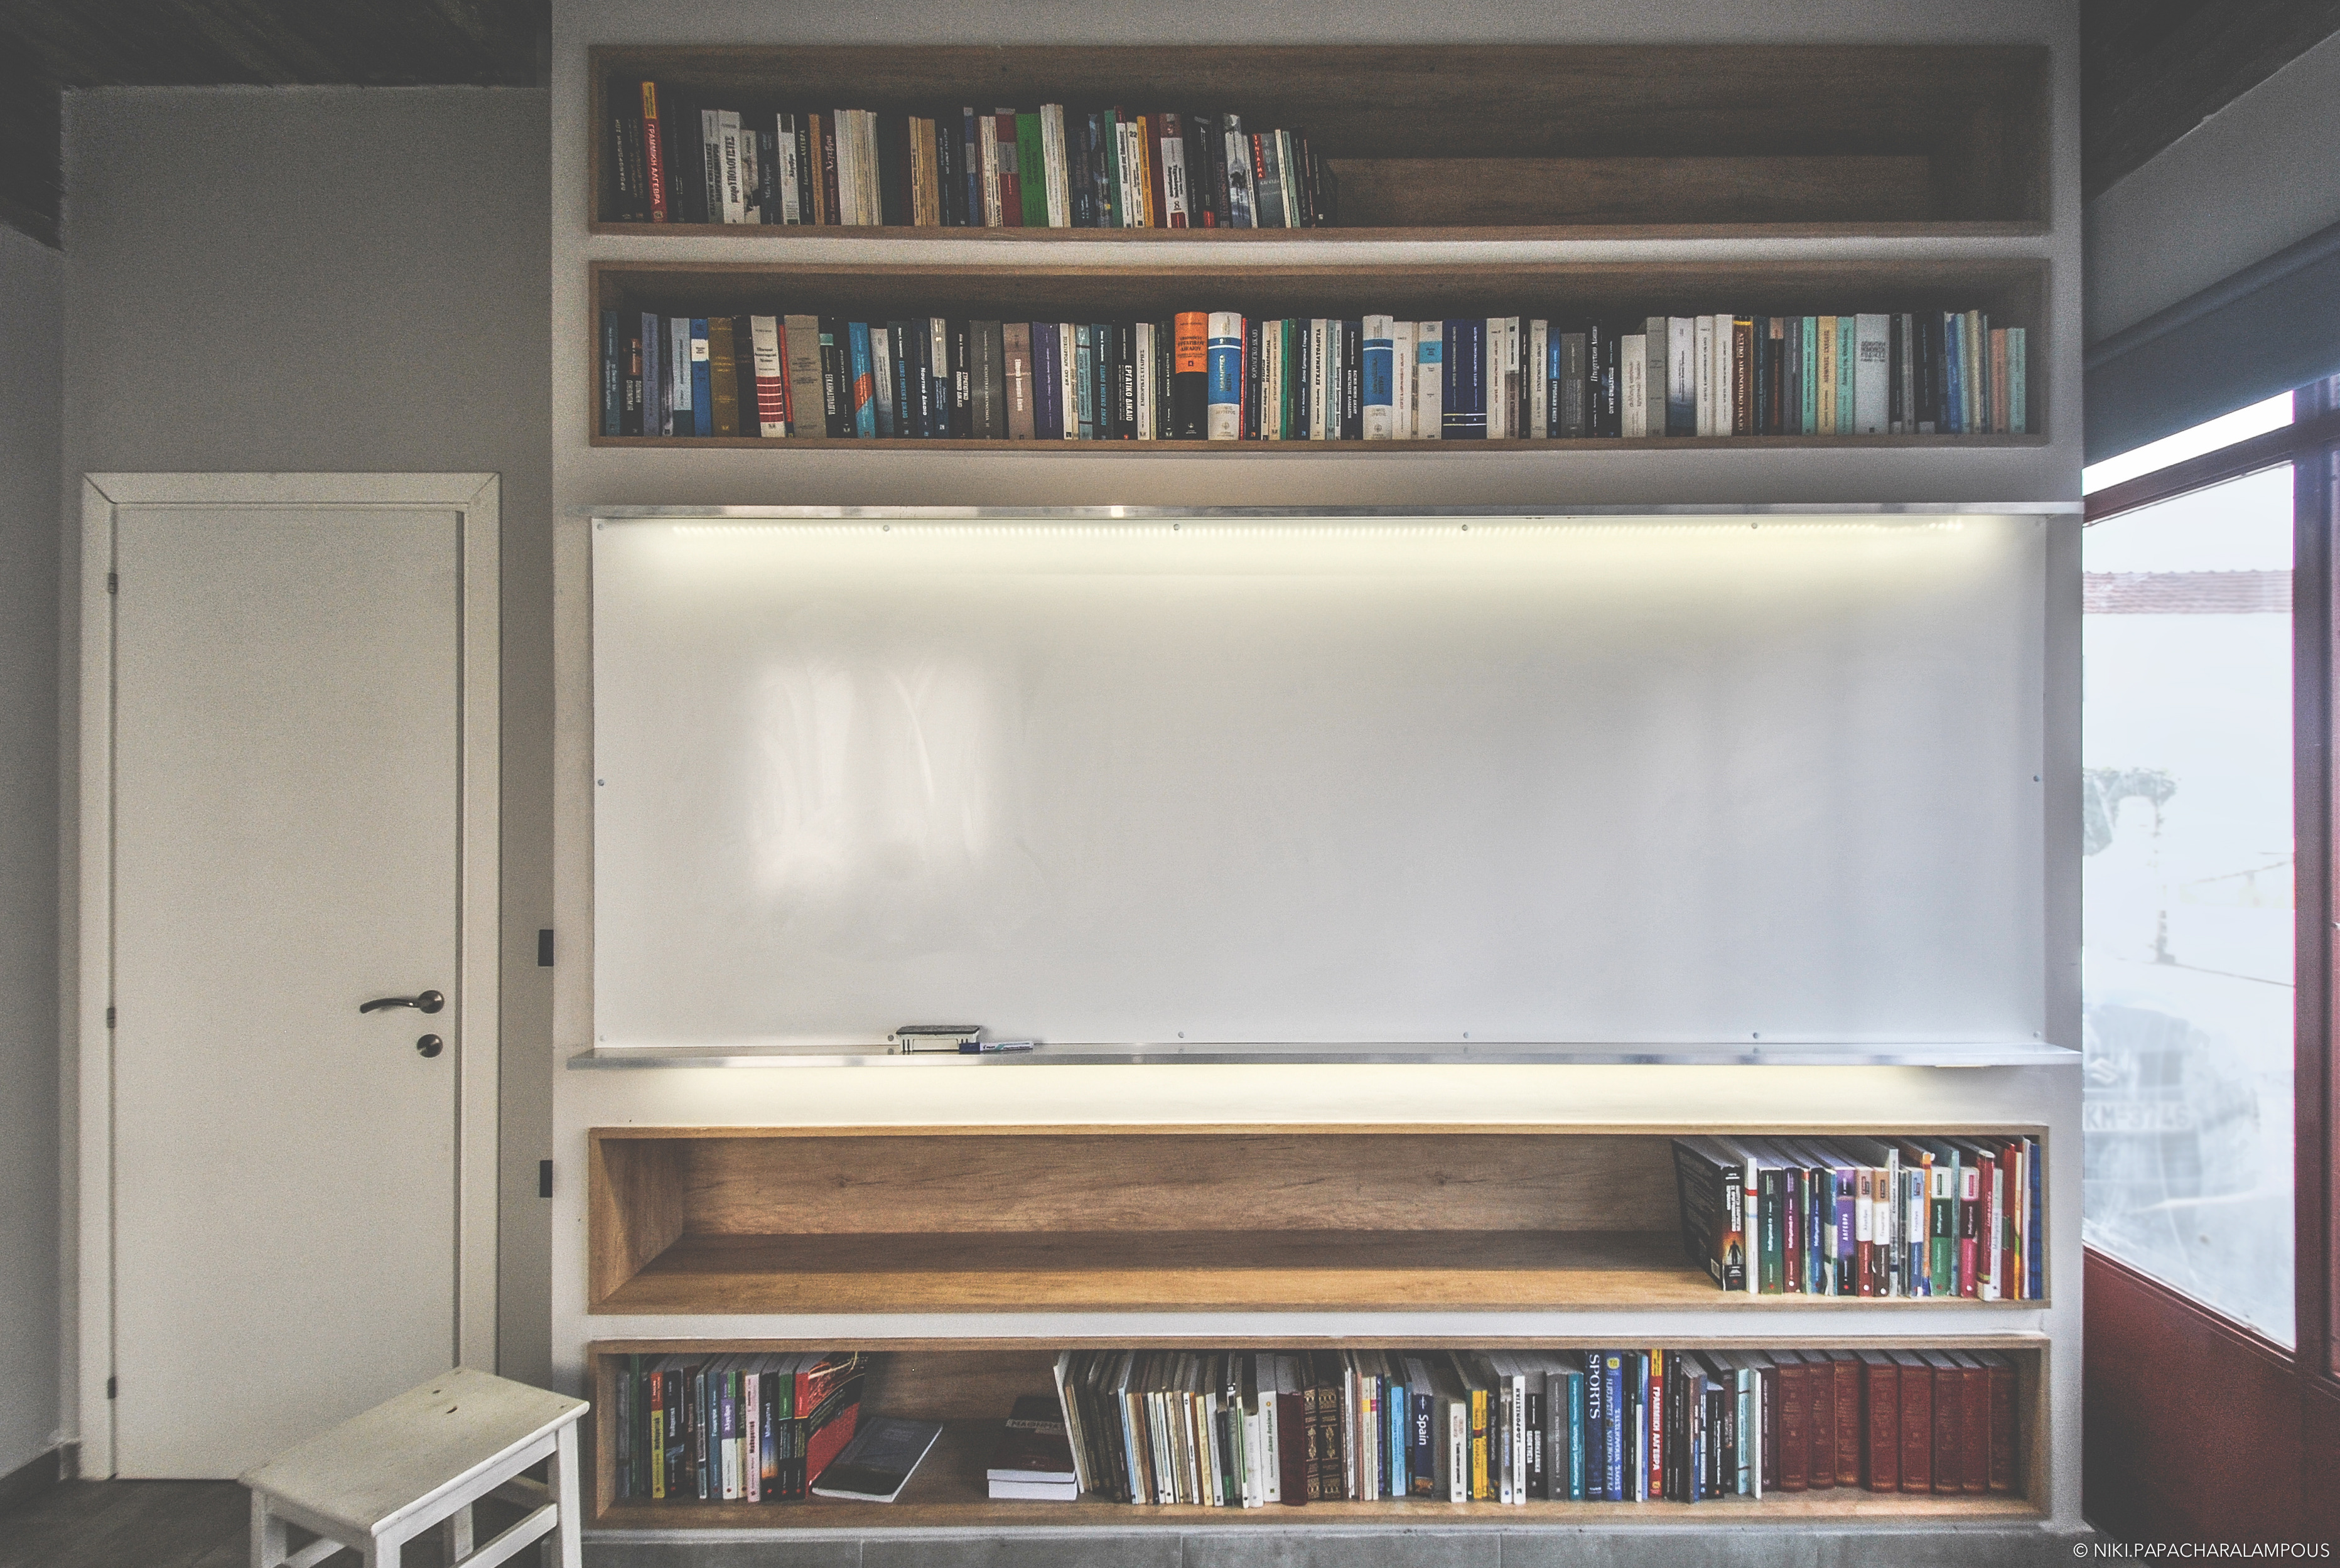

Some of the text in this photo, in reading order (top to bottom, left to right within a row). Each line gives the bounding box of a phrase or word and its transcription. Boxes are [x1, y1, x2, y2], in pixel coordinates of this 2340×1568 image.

[647, 124, 657, 166] ΓΡΑΜΜΙΚΗ
[651, 168, 660, 205] ΑΛΓΕΒΡΑ
[825, 373, 835, 415] ΕΓΚΛΗΜΑΤΟΛΟΓΙΑ
[1124, 365, 1133, 397] ΕΡΓΑΤΙΚΟ
[1590, 1354, 1600, 1419] SPORTS
[1417, 1414, 1429, 1446] Spain
